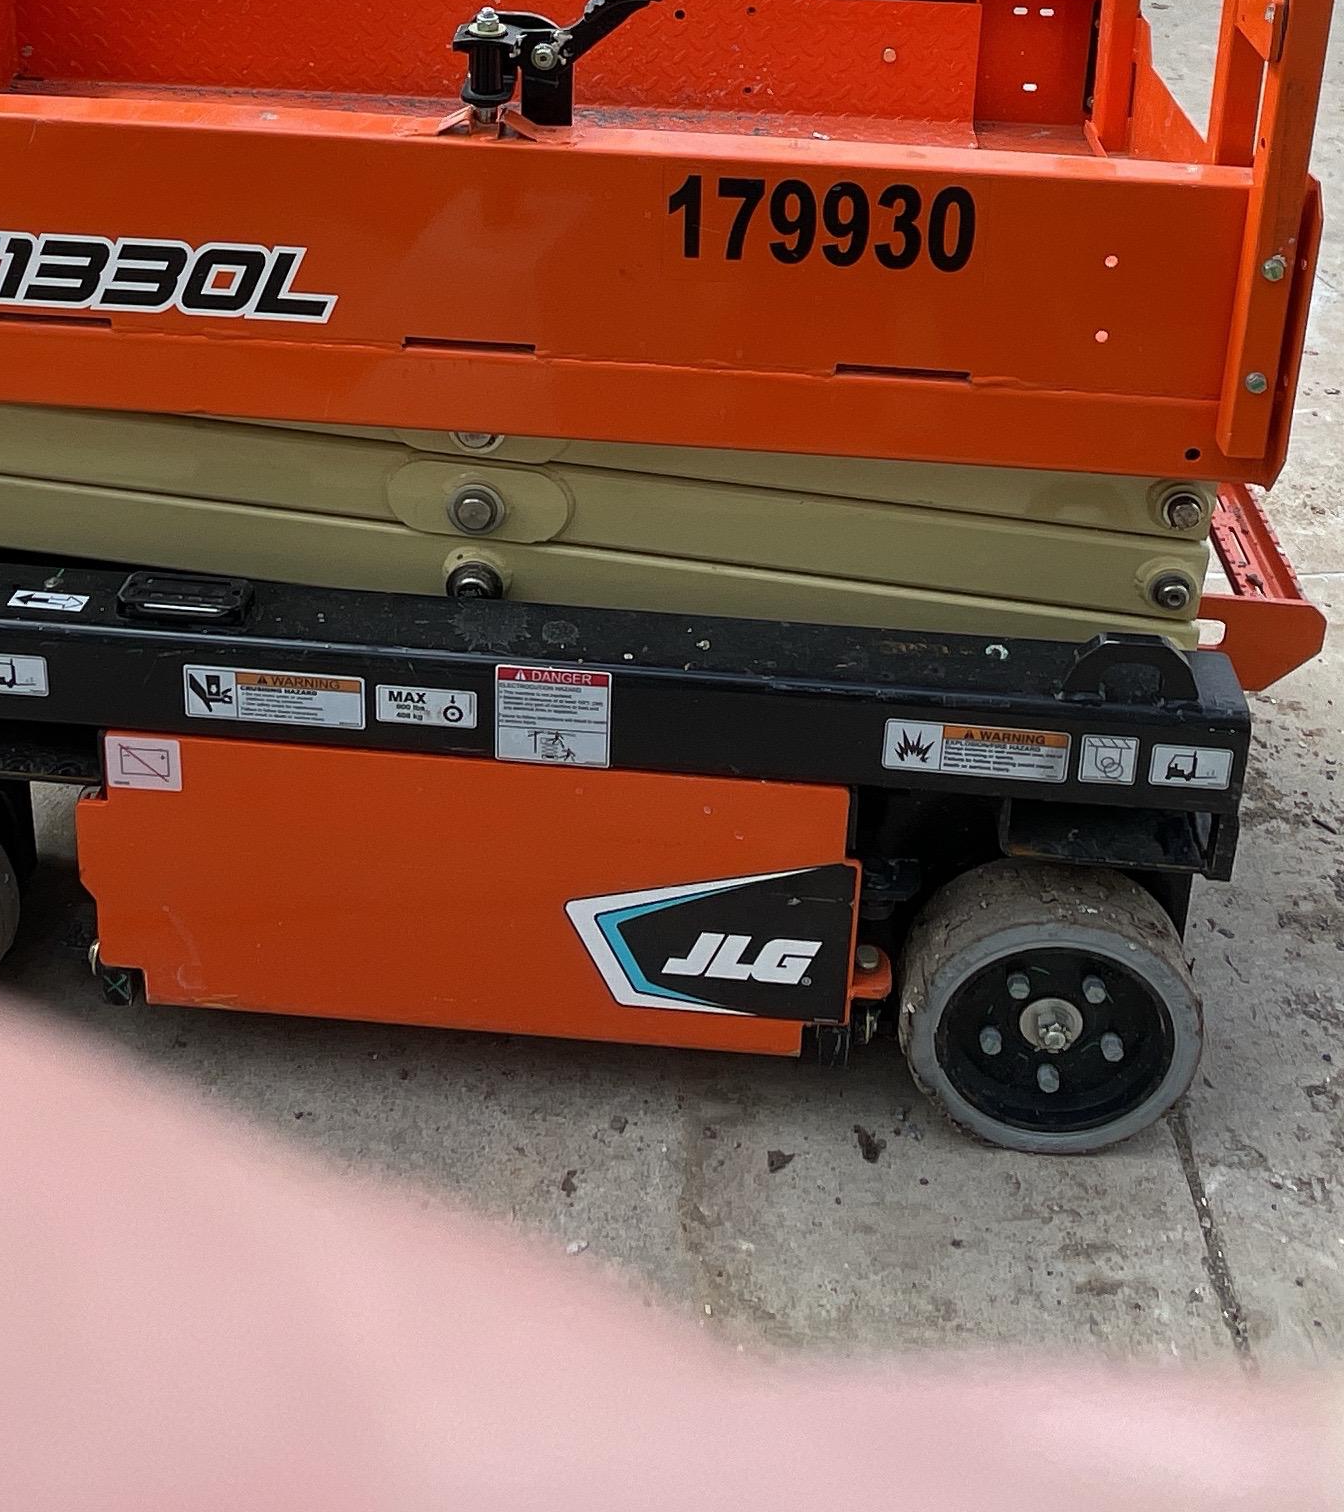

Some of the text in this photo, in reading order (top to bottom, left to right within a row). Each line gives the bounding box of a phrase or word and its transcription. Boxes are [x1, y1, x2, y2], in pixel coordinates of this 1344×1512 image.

[667, 175, 977, 273] 179930
[271, 676, 340, 690] WARNING
[532, 670, 592, 685] DANGER
[388, 690, 427, 704] MAX
[980, 730, 1045, 745] WARNING
[660, 931, 823, 985] JLG
